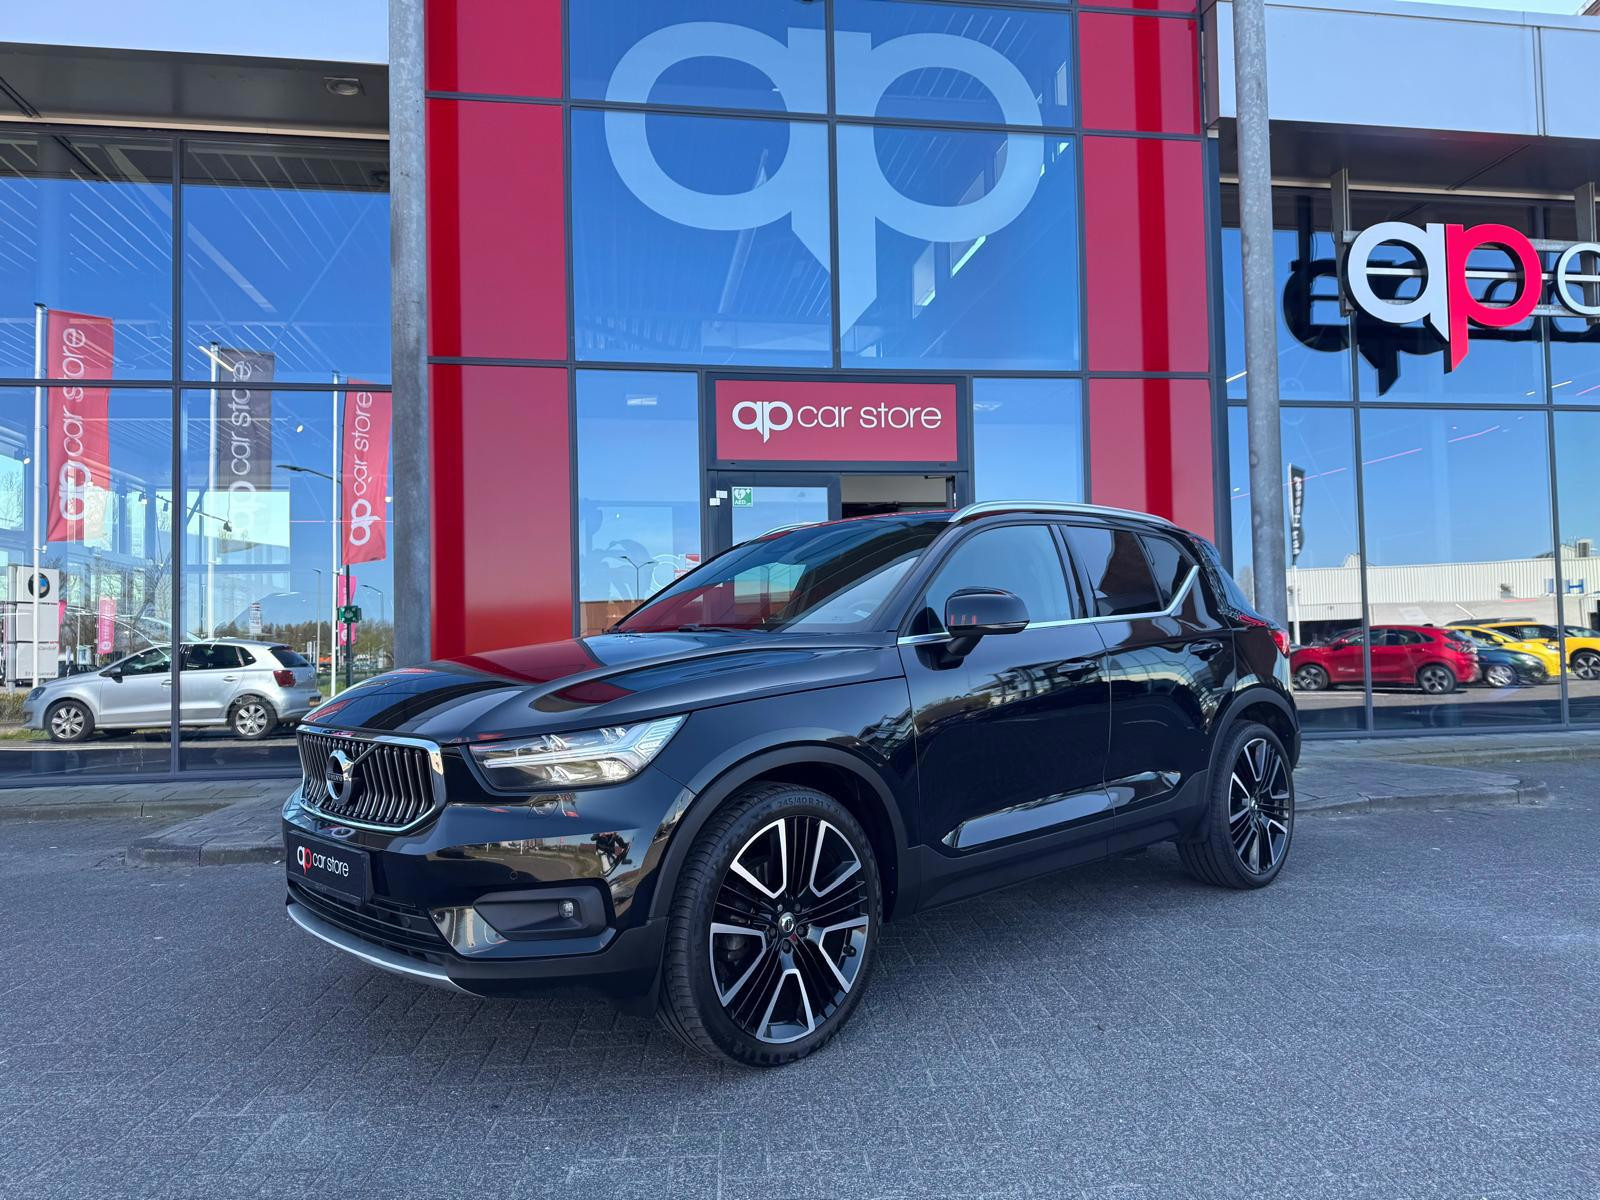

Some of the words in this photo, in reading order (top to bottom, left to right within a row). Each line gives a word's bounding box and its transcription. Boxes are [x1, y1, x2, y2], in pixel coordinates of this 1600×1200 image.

[604, 21, 1045, 338] ap
[1348, 221, 1543, 372] ap
[228, 361, 252, 427] stoe
[63, 404, 84, 456] car
[352, 391, 373, 452] store
[732, 401, 793, 444] ap
[797, 406, 853, 428] car
[859, 402, 942, 429] store
[231, 431, 251, 475] car
[353, 454, 371, 496] car
[349, 498, 381, 546] ap
[297, 845, 312, 876] ap
[313, 853, 326, 869] car
[327, 856, 349, 877] store
